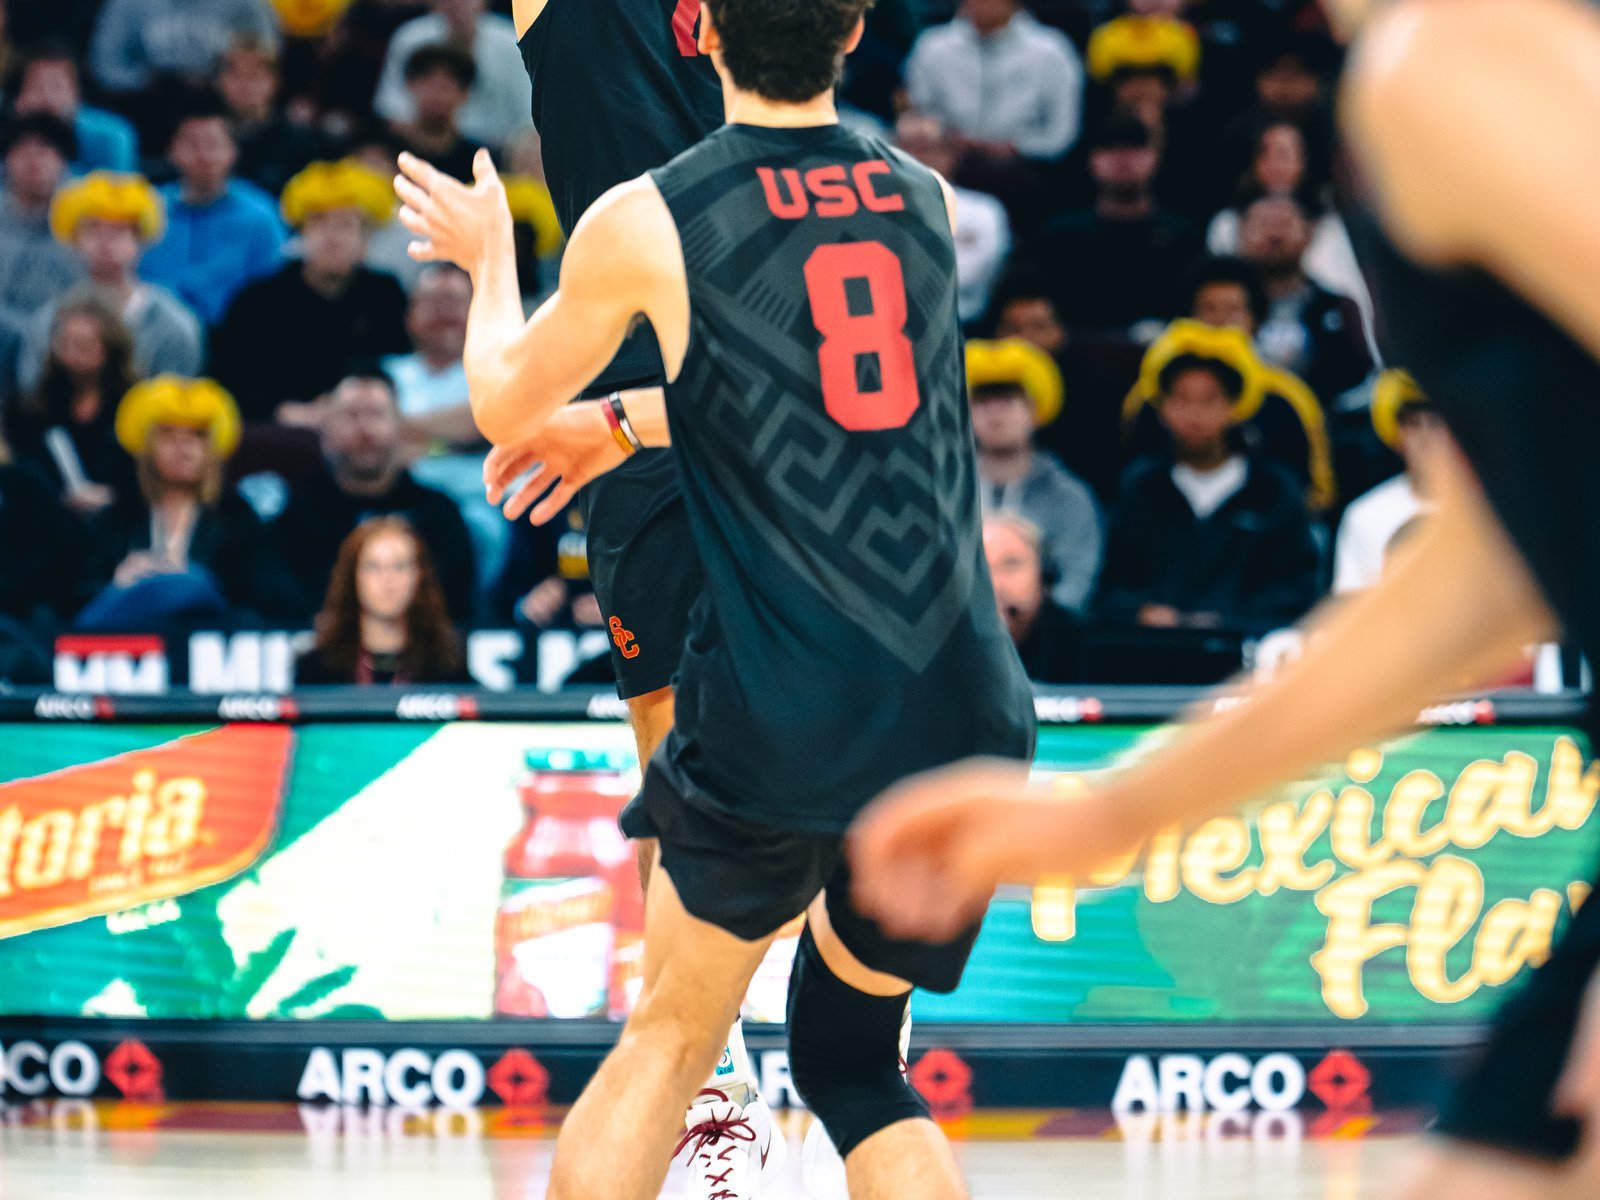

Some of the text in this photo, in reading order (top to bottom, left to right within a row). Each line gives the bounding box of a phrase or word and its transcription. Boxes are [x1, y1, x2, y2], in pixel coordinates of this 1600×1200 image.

[756, 160, 905, 220] USC
[803, 240, 921, 432] 8
[35, 695, 95, 719] ARCO
[218, 696, 279, 720] ARCO
[1311, 854, 1592, 1019] Fla
[0, 1039, 100, 1097] CO
[297, 1046, 486, 1107] ARCO
[1111, 1053, 1305, 1113] ARCO
